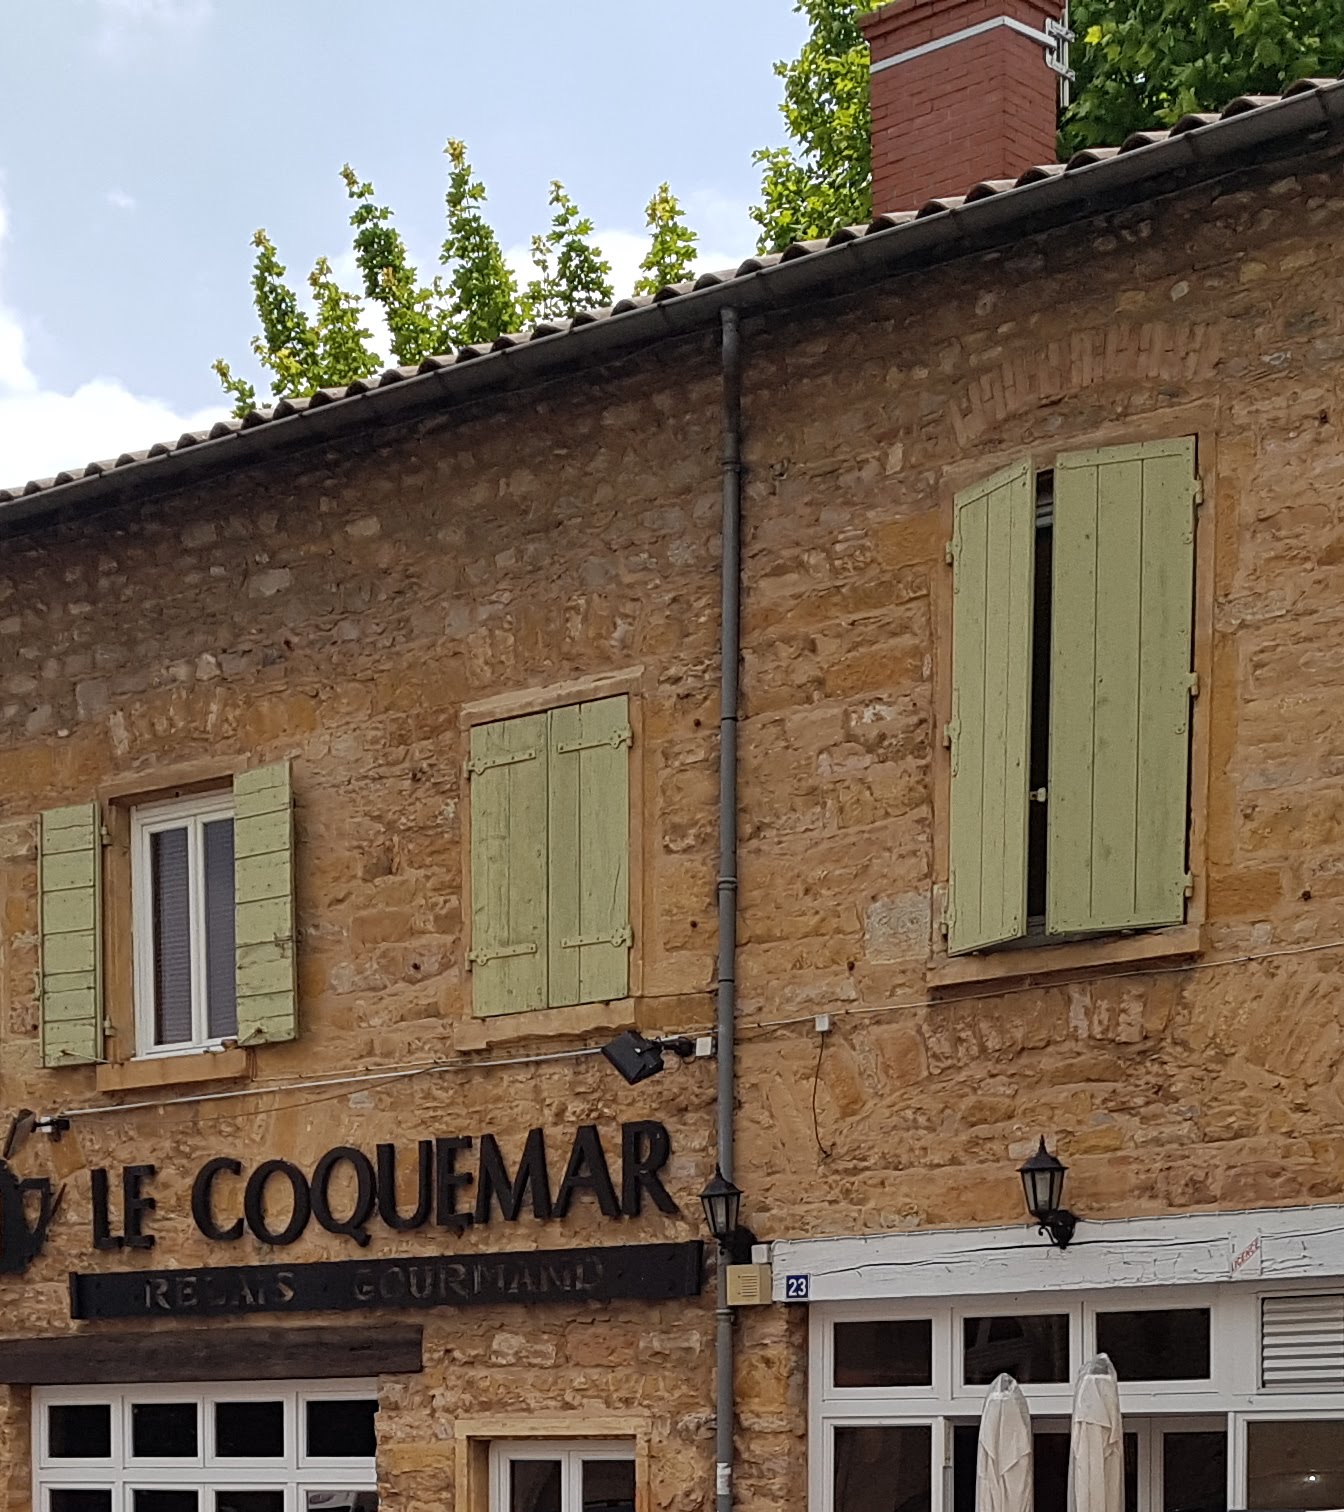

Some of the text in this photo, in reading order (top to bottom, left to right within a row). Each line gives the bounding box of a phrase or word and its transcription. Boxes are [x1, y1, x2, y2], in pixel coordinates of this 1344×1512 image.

[91, 1120, 679, 1249] LE COQUEMAR
[788, 1278, 807, 1297] 23
